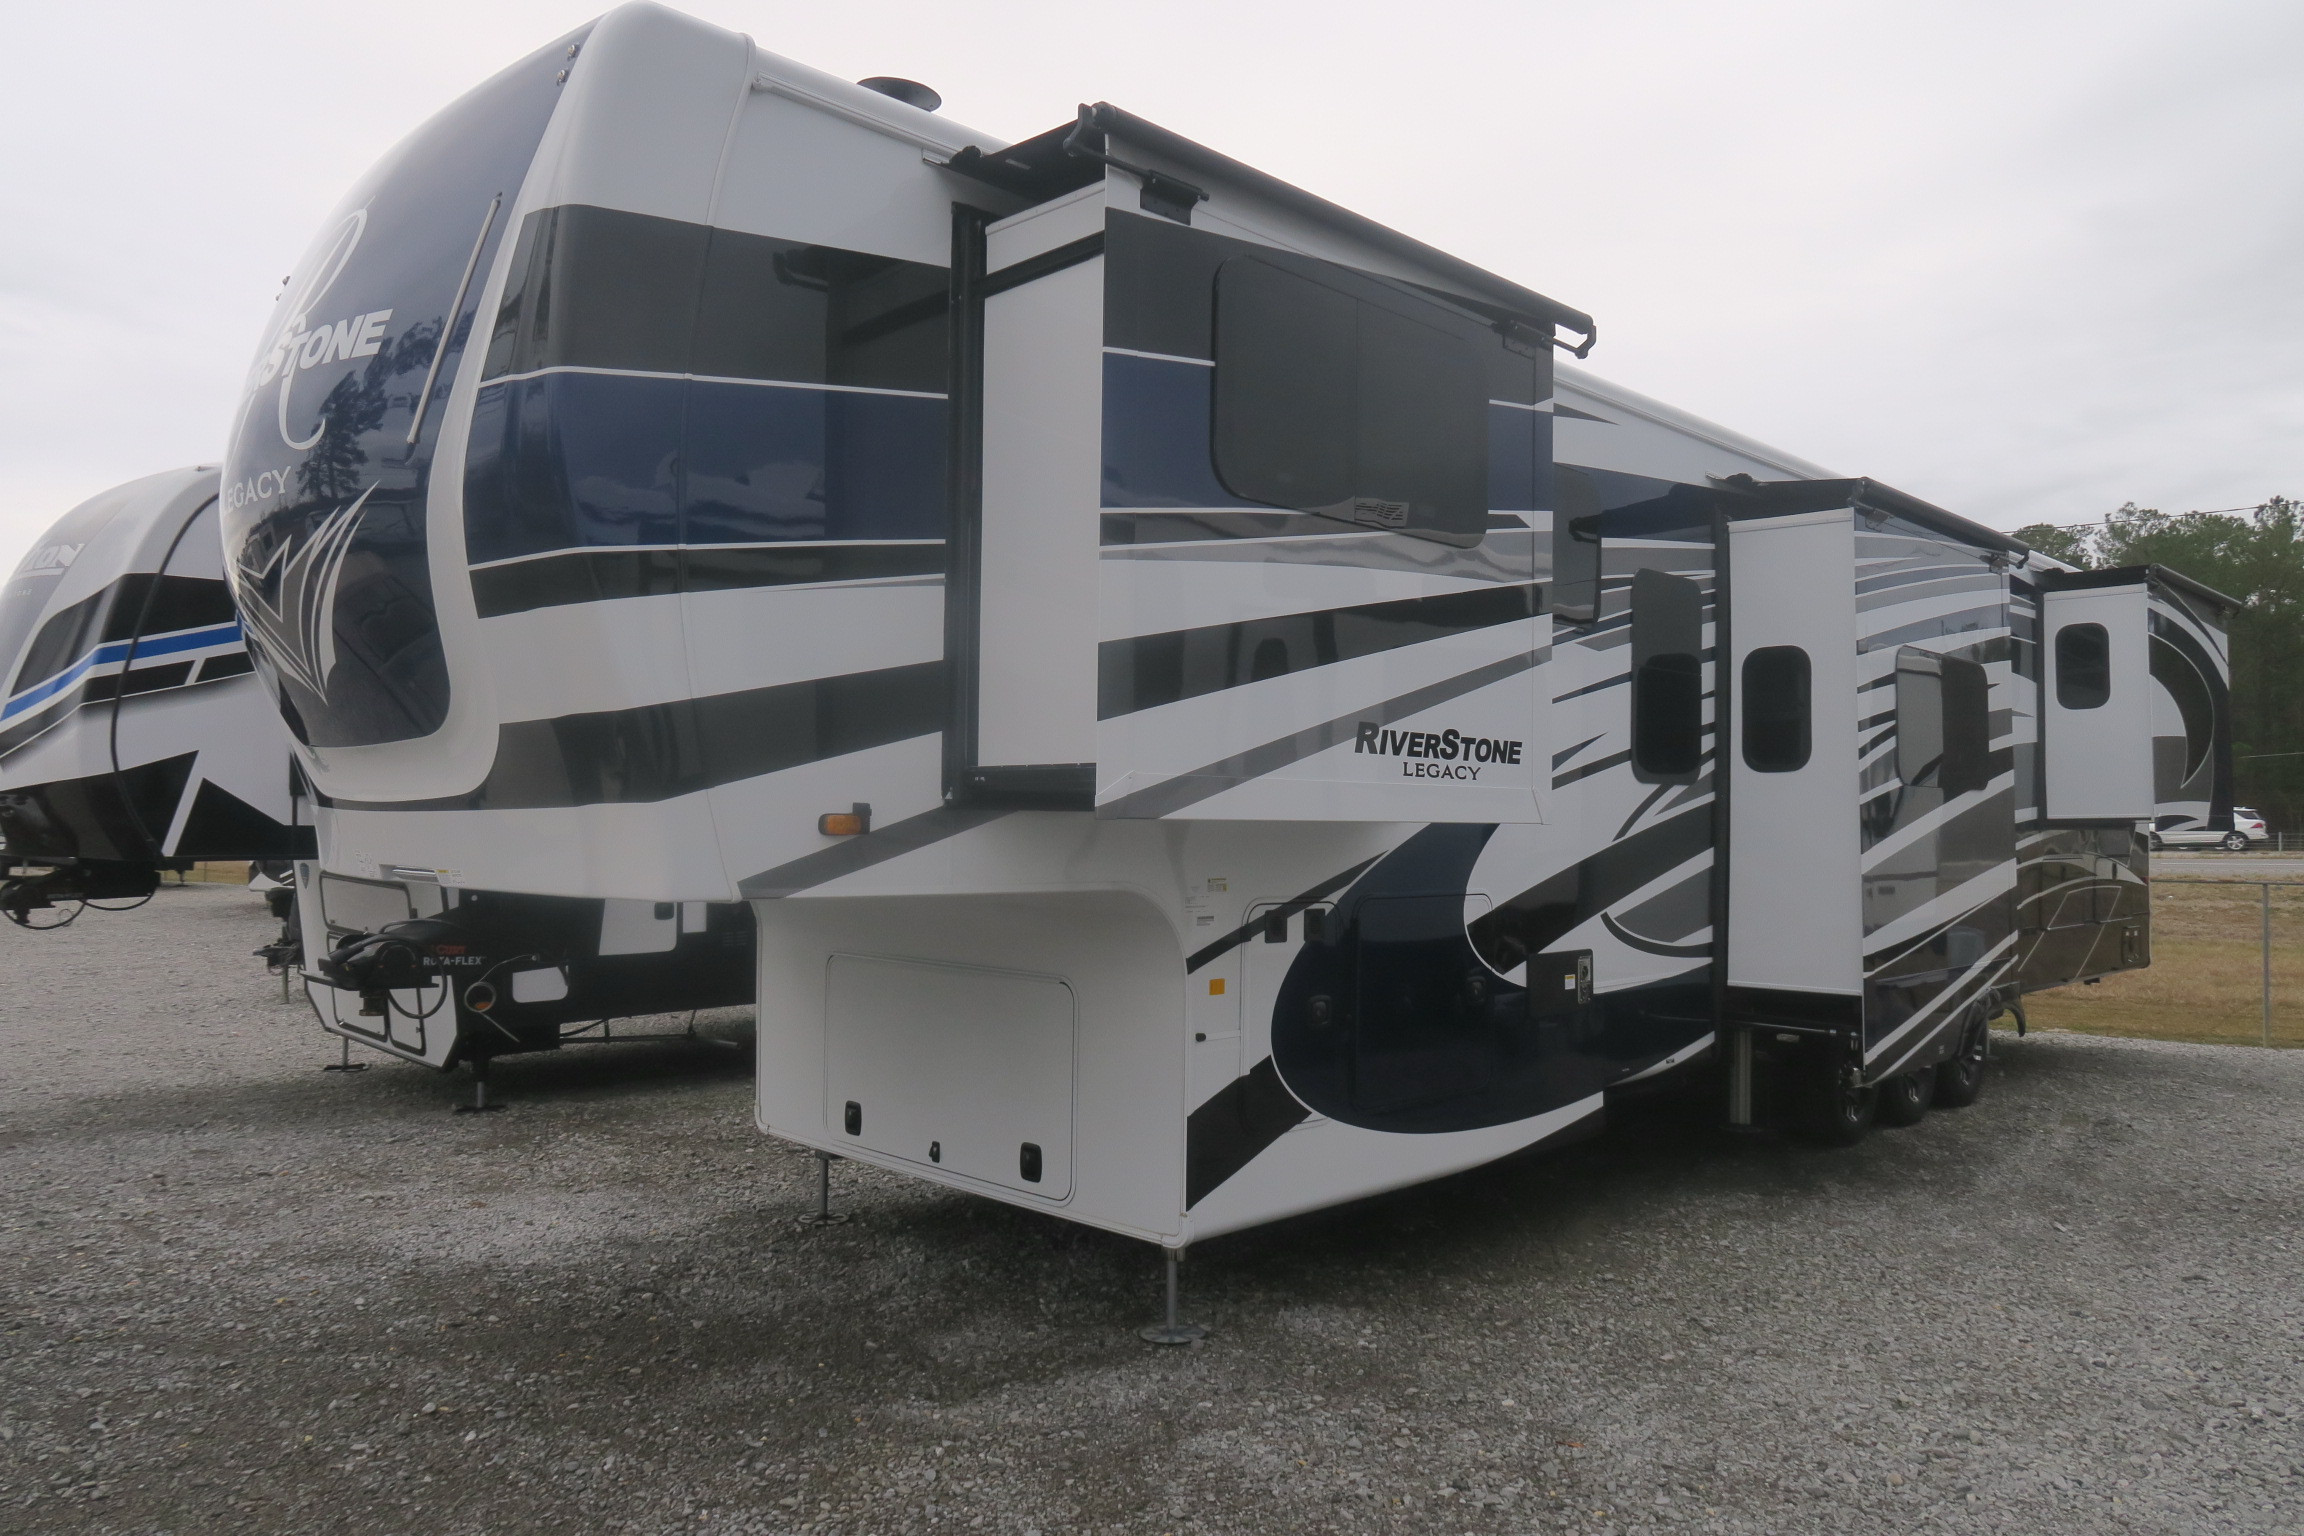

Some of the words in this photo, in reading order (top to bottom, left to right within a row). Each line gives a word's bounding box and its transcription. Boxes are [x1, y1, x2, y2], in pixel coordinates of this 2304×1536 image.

[226, 465, 292, 511] EGACY
[1354, 721, 1523, 765] RIVERSTONE
[1402, 761, 1482, 781] LEGACY
